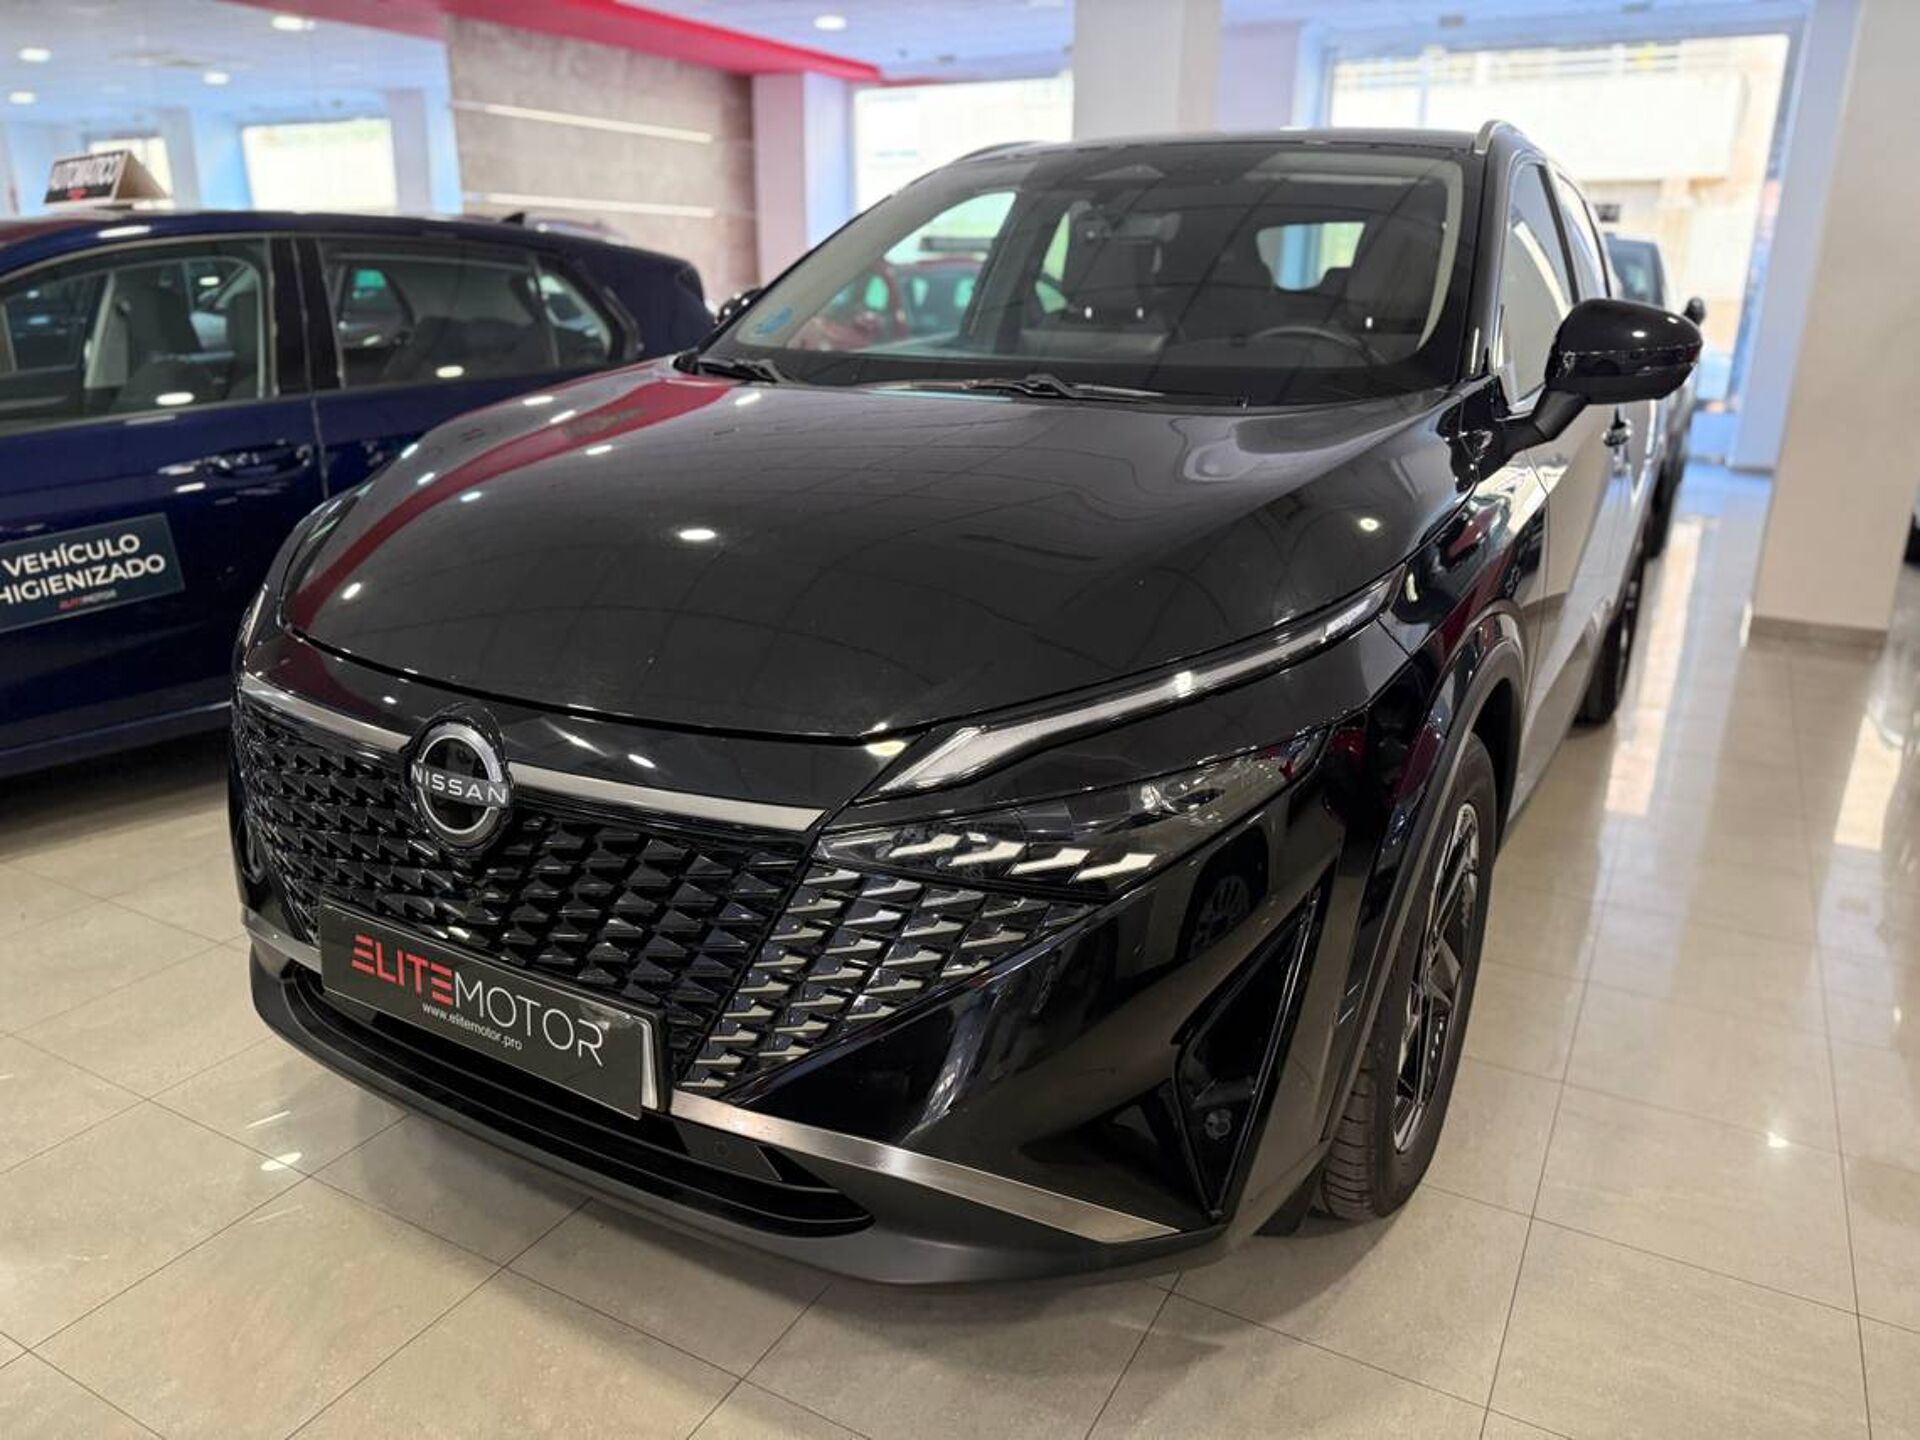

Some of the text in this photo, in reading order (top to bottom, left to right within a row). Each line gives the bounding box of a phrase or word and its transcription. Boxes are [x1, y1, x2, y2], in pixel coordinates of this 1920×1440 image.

[2, 534, 140, 576] VEHÍCULO
[411, 764, 507, 804] NISSAN
[352, 934, 605, 1066] ELITEMOTOR
[421, 1002, 523, 1052] www.elitemotor.pro
